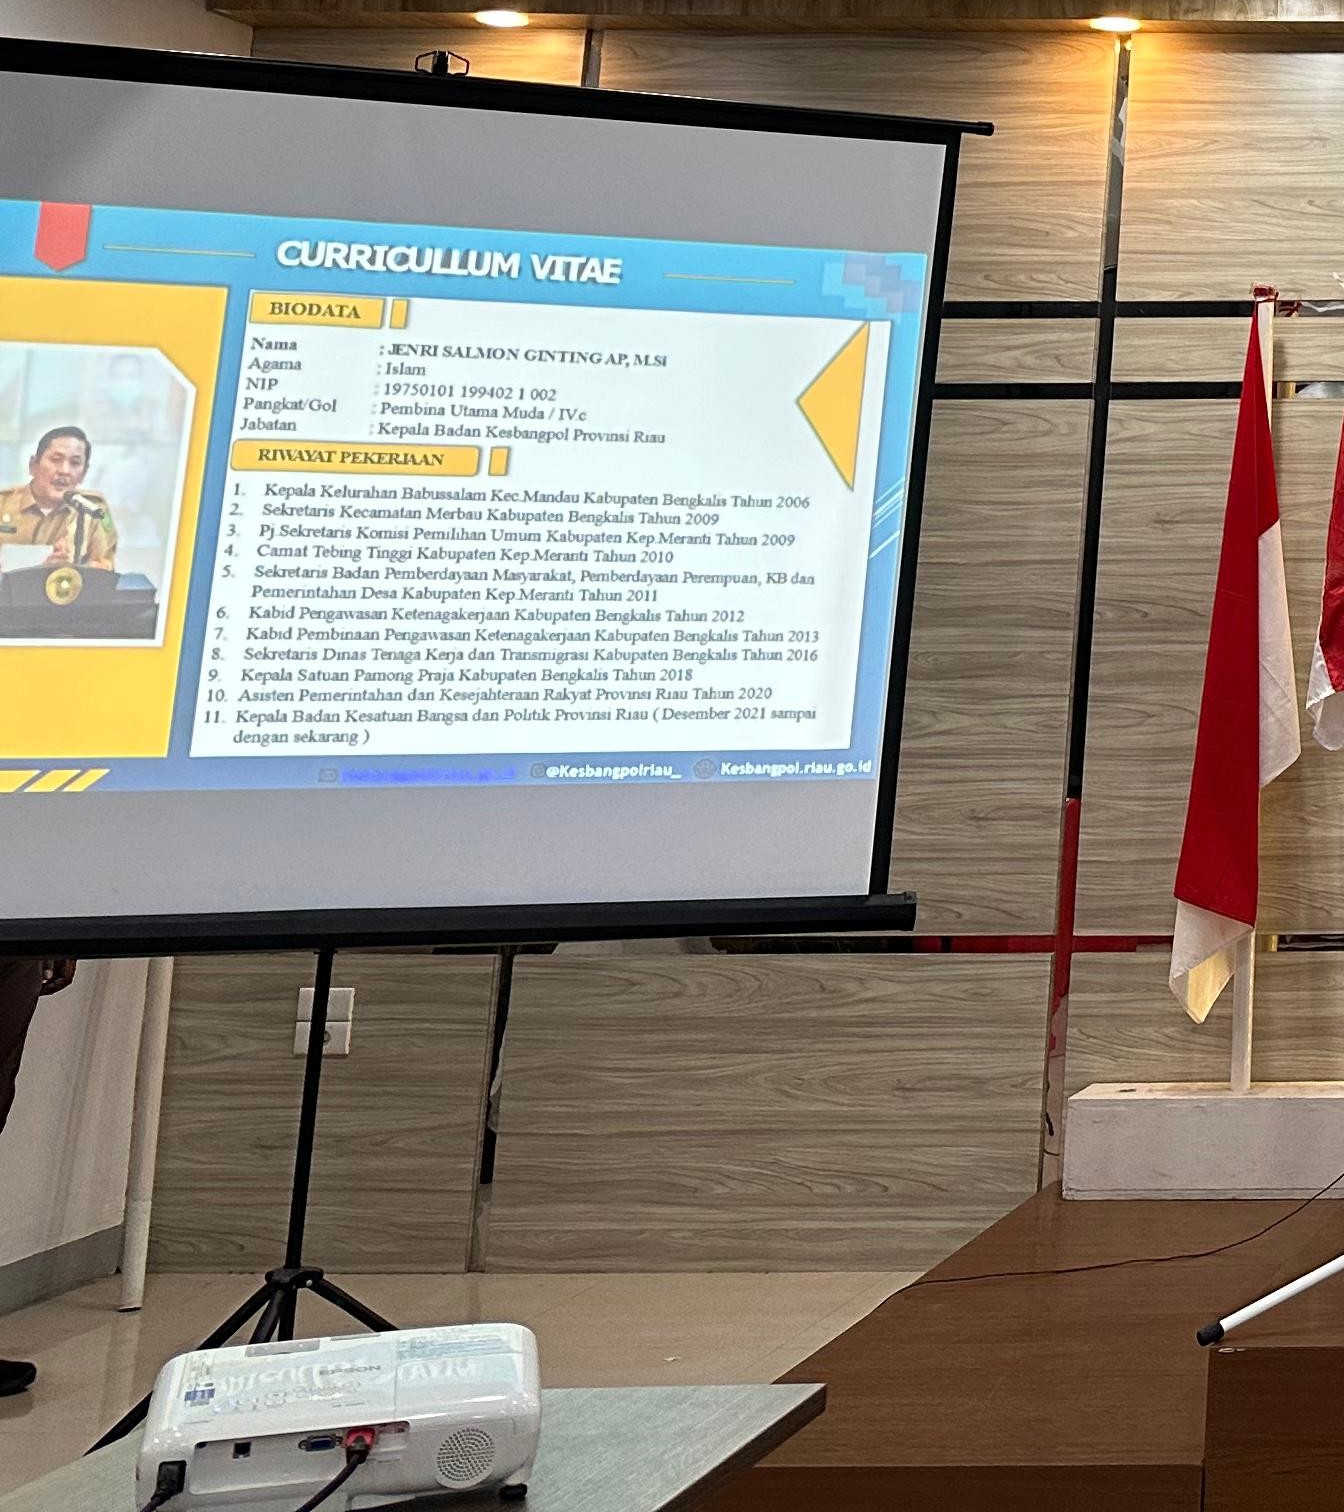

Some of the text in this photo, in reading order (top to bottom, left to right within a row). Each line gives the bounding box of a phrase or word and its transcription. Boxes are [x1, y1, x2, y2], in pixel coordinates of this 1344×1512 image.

[277, 240, 622, 284] CURRICULLUM VITAE
[267, 301, 362, 320] BIODATA
[249, 336, 298, 352] Nama
[387, 343, 440, 358] JENRI
[441, 345, 521, 361] SALMON
[523, 348, 603, 365] GINTING
[247, 356, 427, 377] Agama Islam
[244, 376, 279, 391] NIP
[383, 382, 454, 398] 19750101
[460, 385, 514, 401] 199402
[529, 387, 557, 402] 002
[379, 401, 446, 417] Pembina
[450, 403, 499, 419] Utama
[501, 405, 545, 421] Muda
[239, 416, 666, 445] Jabatan Kepala Badan Kesbangpol Provinsi Riau
[257, 448, 338, 464] RIWAYAT
[263, 482, 317, 501] Kepala
[319, 484, 398, 500] Kelurahan
[400, 486, 487, 502] Babussalam
[582, 490, 659, 509] Kabupaten
[661, 493, 728, 511] Bengkalis
[730, 494, 773, 509] Tahun
[775, 495, 811, 509] 2006
[261, 502, 720, 528] Sekretaris Kecamatan Merbau Kabupaten Bengkalis Tahun 2009
[256, 543, 309, 558] Camat
[311, 543, 363, 563] Tebing
[365, 545, 413, 564] Tinggi
[416, 545, 496, 565] Kabupaten
[592, 548, 637, 564] Tahun
[639, 550, 675, 564] 2010
[253, 563, 329, 579] Sekretaris
[331, 565, 380, 580] Badan
[383, 565, 489, 585] Pemberdayaan
[579, 569, 679, 587] Pemberdayaan
[765, 571, 788, 585] KB
[789, 571, 816, 586] dan
[250, 584, 357, 600] Pemerintahan
[359, 586, 398, 600] Desa
[400, 585, 482, 605] Kabupaten
[578, 588, 623, 602] Tahun
[625, 589, 658, 603] 2011
[248, 604, 745, 626] Kabid Pengawasan Ketenagakerjaan Kabupaten Bengkalis Tahun 2012
[239, 667, 694, 686] Kepala Satuan Pamong Praja Kabupaten Bengkalis Tahun 2018
[236, 686, 773, 706] Asisten Pemerintahan dan Kesejahteraan Rakyat Provinsi Riau Tahun 2020
[234, 706, 817, 728] Kepala Badan Kesatuan Bangsa dan Politik Provinsi Riau Desember 2021 sampai
[232, 729, 359, 748] dengan sekarang
